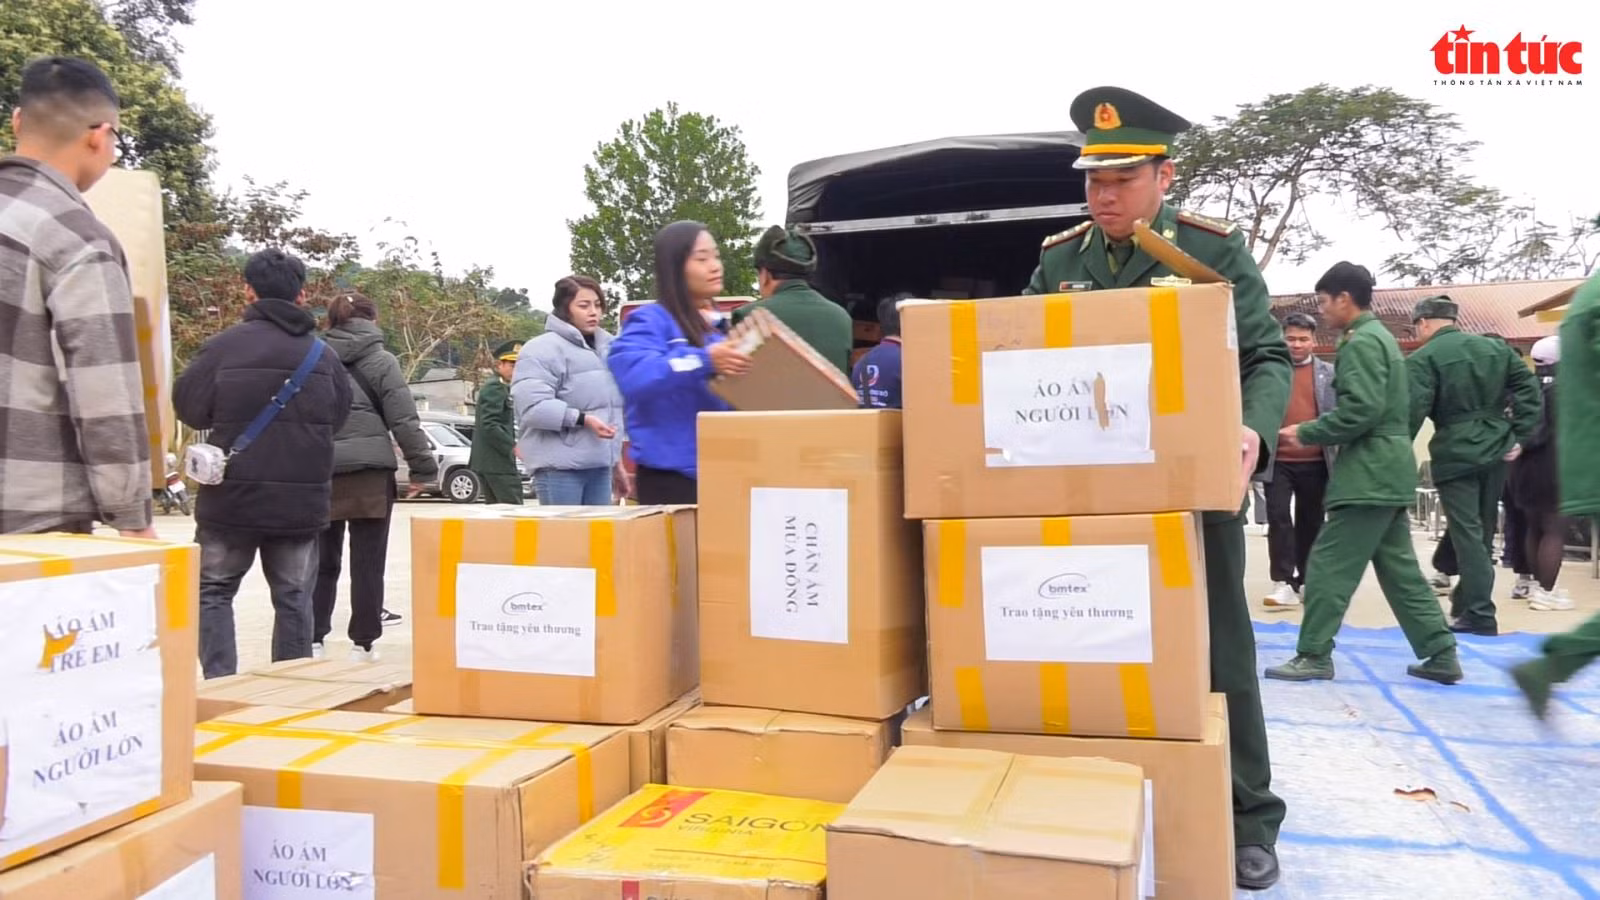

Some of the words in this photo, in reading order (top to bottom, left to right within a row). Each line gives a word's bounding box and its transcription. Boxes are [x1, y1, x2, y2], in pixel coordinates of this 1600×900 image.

[1034, 379, 1061, 398] ÁO
[1016, 404, 1080, 424] NGƯỜI
[784, 515, 800, 556] MÙA
[1049, 584, 1088, 594] bmtex
[510, 602, 544, 611] bmtex
[1001, 606, 1029, 618] Trao
[1032, 607, 1060, 621] tặng
[1063, 606, 1085, 620] yêu
[1088, 607, 1135, 620] thương
[470, 621, 494, 632] Trao
[496, 622, 520, 635] tặng
[543, 624, 582, 637] thương
[91, 642, 121, 665] EM
[53, 720, 84, 748] ÁO
[32, 747, 101, 788] NGƯỜI
[271, 839, 295, 860] ÁO
[253, 865, 311, 889] NGƯỜI
